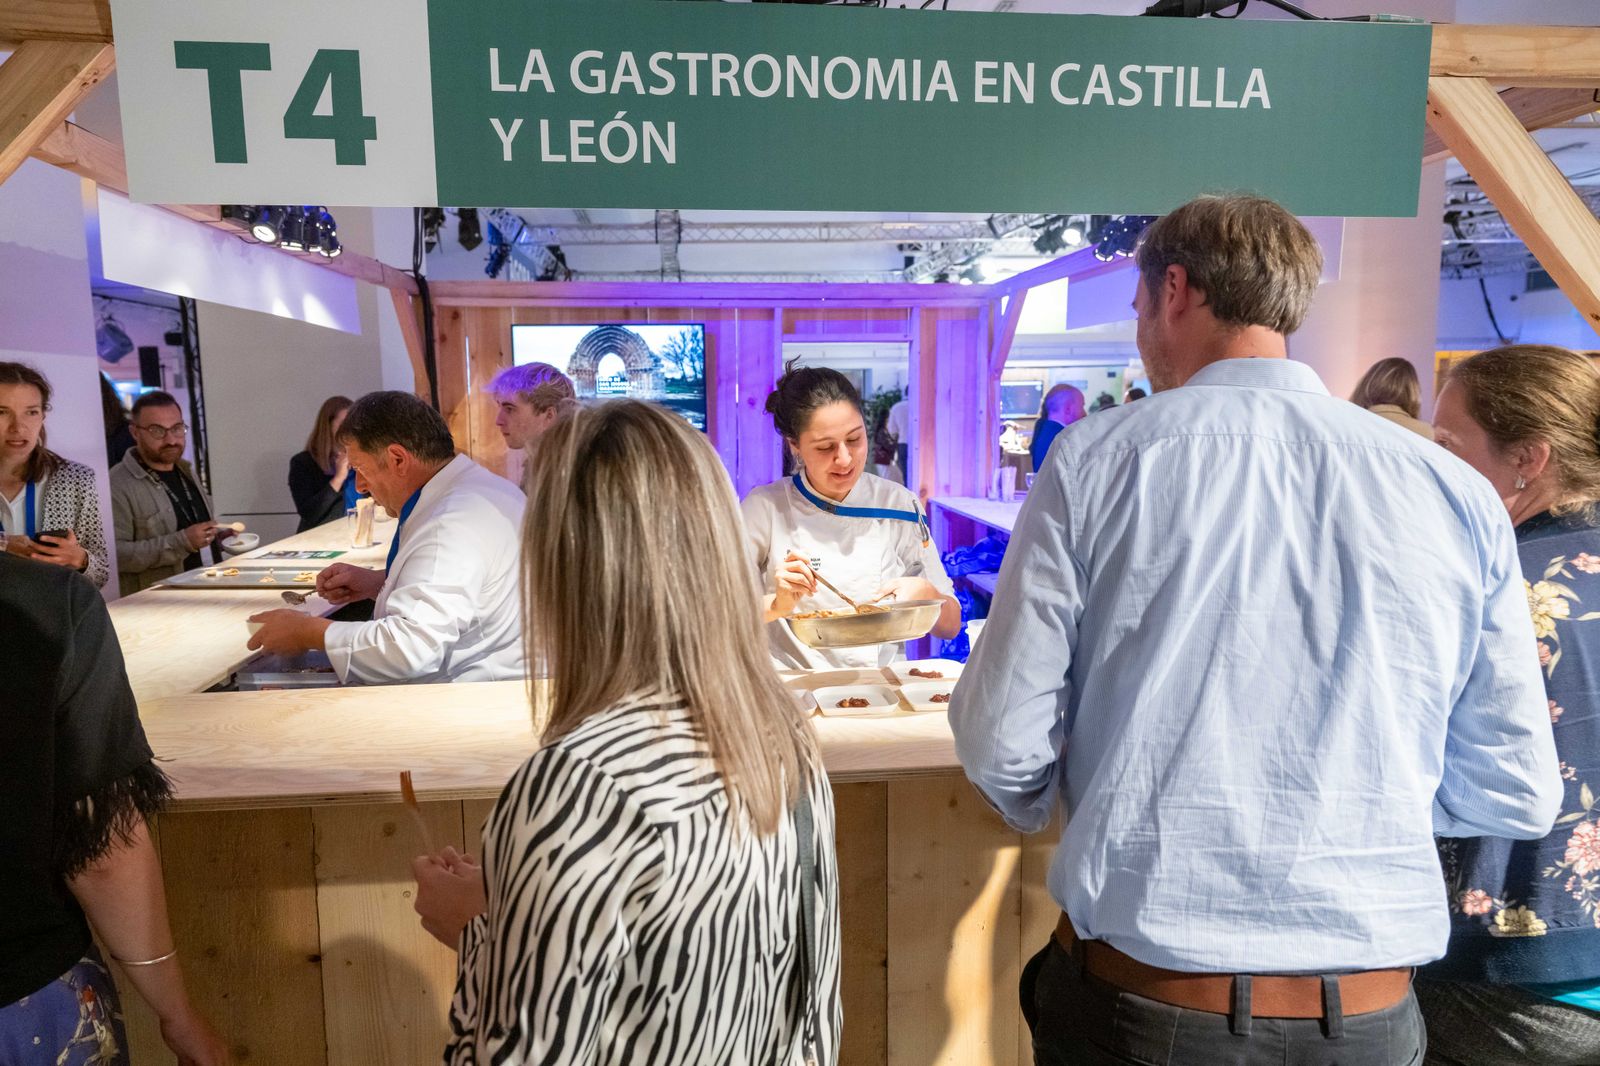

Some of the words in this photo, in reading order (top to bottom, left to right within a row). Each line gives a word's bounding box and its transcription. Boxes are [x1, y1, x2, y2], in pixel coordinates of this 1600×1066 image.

[173, 41, 378, 166] T4
[489, 47, 556, 93] LA
[570, 50, 959, 102] GASTRONOMIA
[974, 61, 1035, 104] EN
[1050, 63, 1272, 109] CASTILLA
[489, 118, 524, 161] Y
[540, 110, 677, 165] LEÓN
